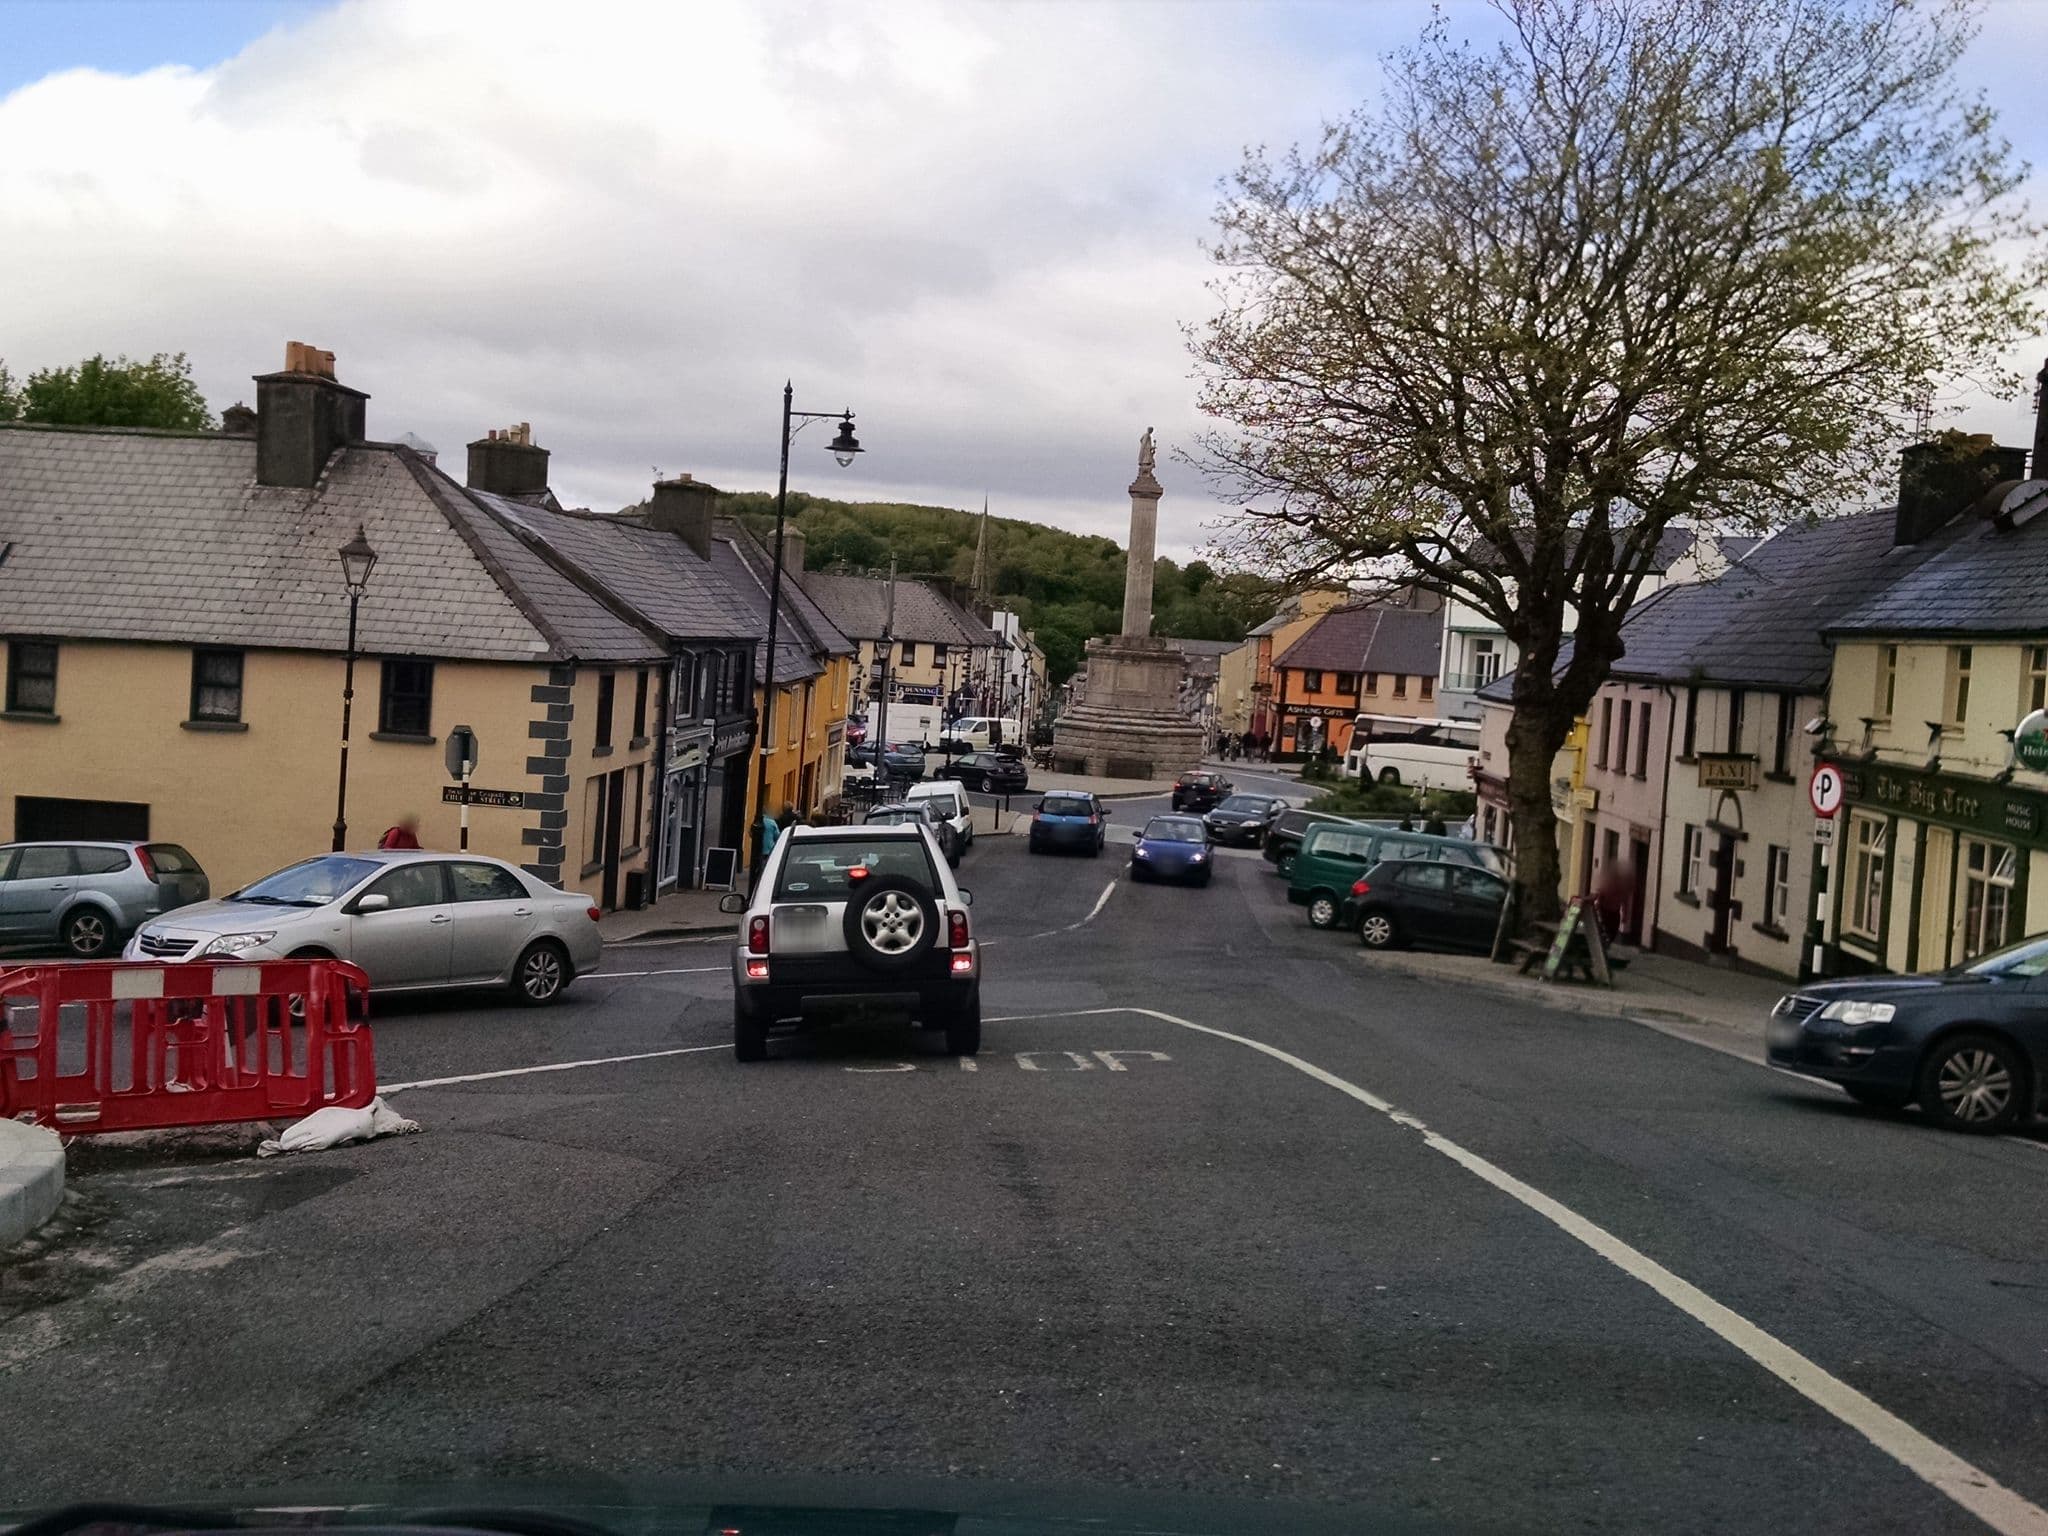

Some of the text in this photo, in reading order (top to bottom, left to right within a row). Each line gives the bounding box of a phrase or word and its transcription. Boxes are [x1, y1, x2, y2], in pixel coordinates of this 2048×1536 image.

[1706, 763, 1745, 777] TAXI
[1820, 774, 1832, 805] P
[1877, 775, 1902, 800] The
[1908, 780, 1936, 813] Big
[1943, 787, 1979, 817] Tree
[2006, 802, 2031, 817] MUSIC
[2005, 816, 2031, 830] HOUSE
